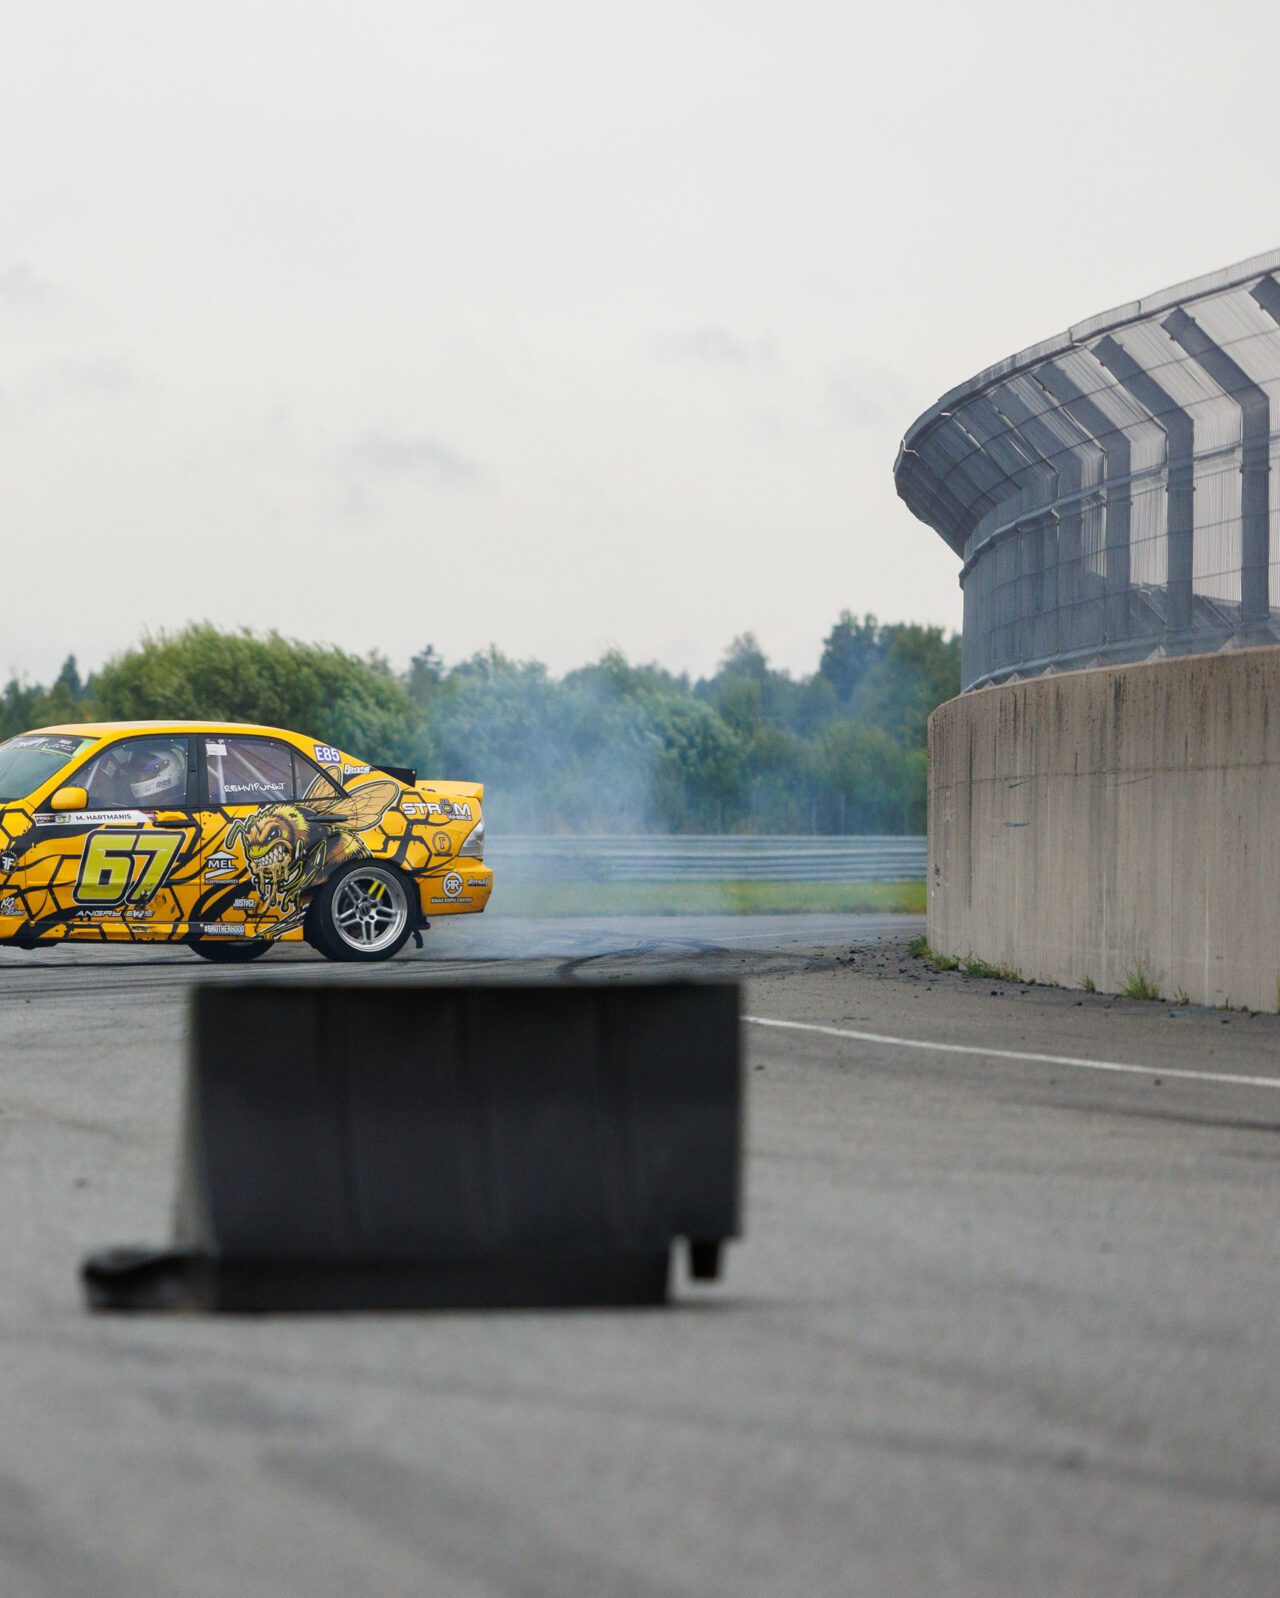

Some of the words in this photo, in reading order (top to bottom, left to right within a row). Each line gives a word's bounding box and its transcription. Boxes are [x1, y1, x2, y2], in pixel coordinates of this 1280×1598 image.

[315, 747, 340, 761] E85
[74, 831, 184, 903] 67
[208, 860, 235, 868] MEL
[204, 925, 245, 933] #BROTHERHOOD
